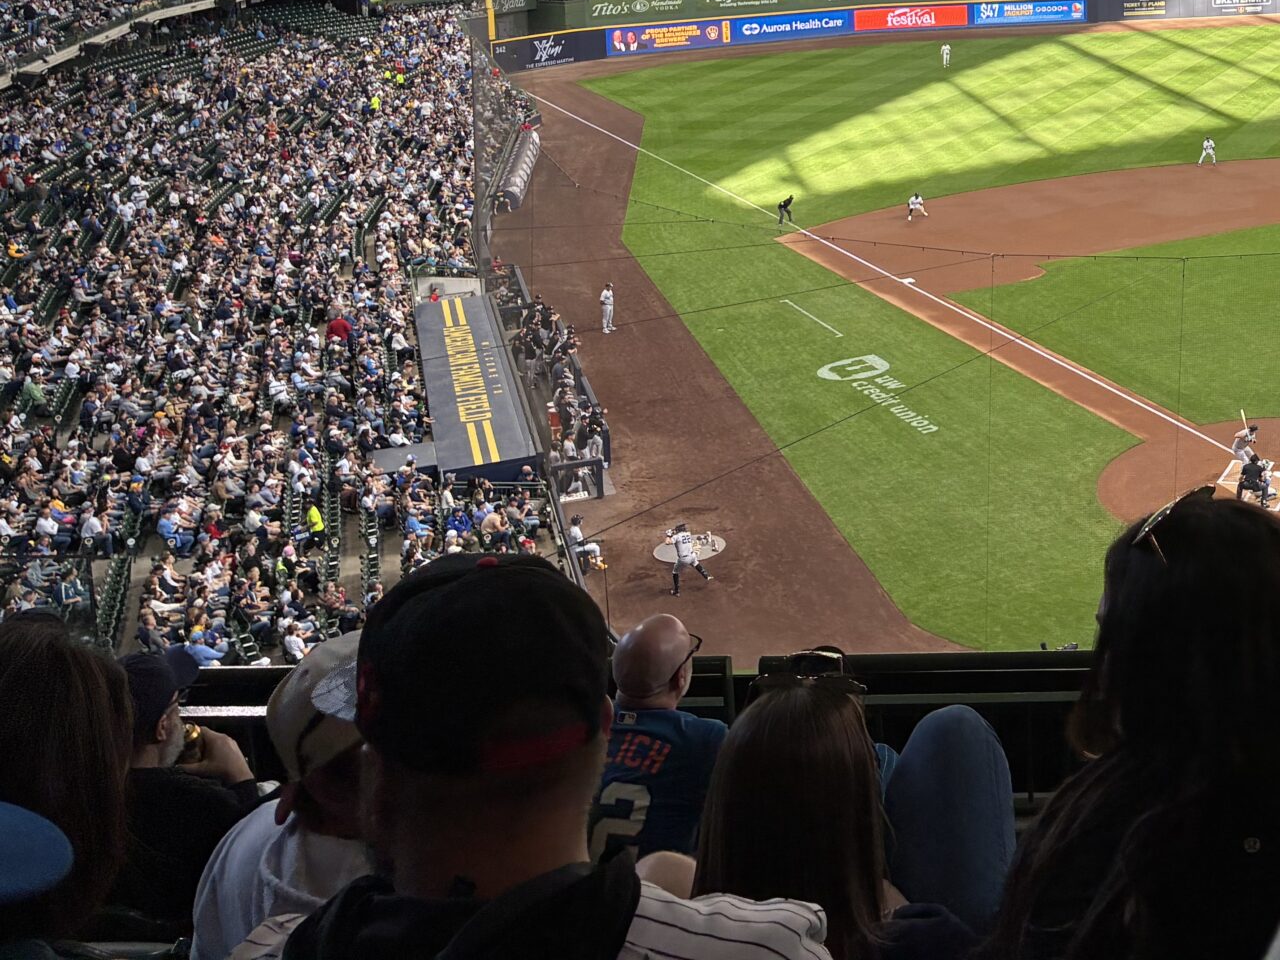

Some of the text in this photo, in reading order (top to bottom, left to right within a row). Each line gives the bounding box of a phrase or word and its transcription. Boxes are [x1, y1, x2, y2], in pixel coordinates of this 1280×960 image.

[886, 10, 936, 27] festival
[980, 3, 999, 19] $47
[1004, 3, 1033, 11] MILLION
[761, 17, 843, 33] Aurora Health Care
[874, 375, 907, 390] uw
[851, 380, 939, 434] credit union
